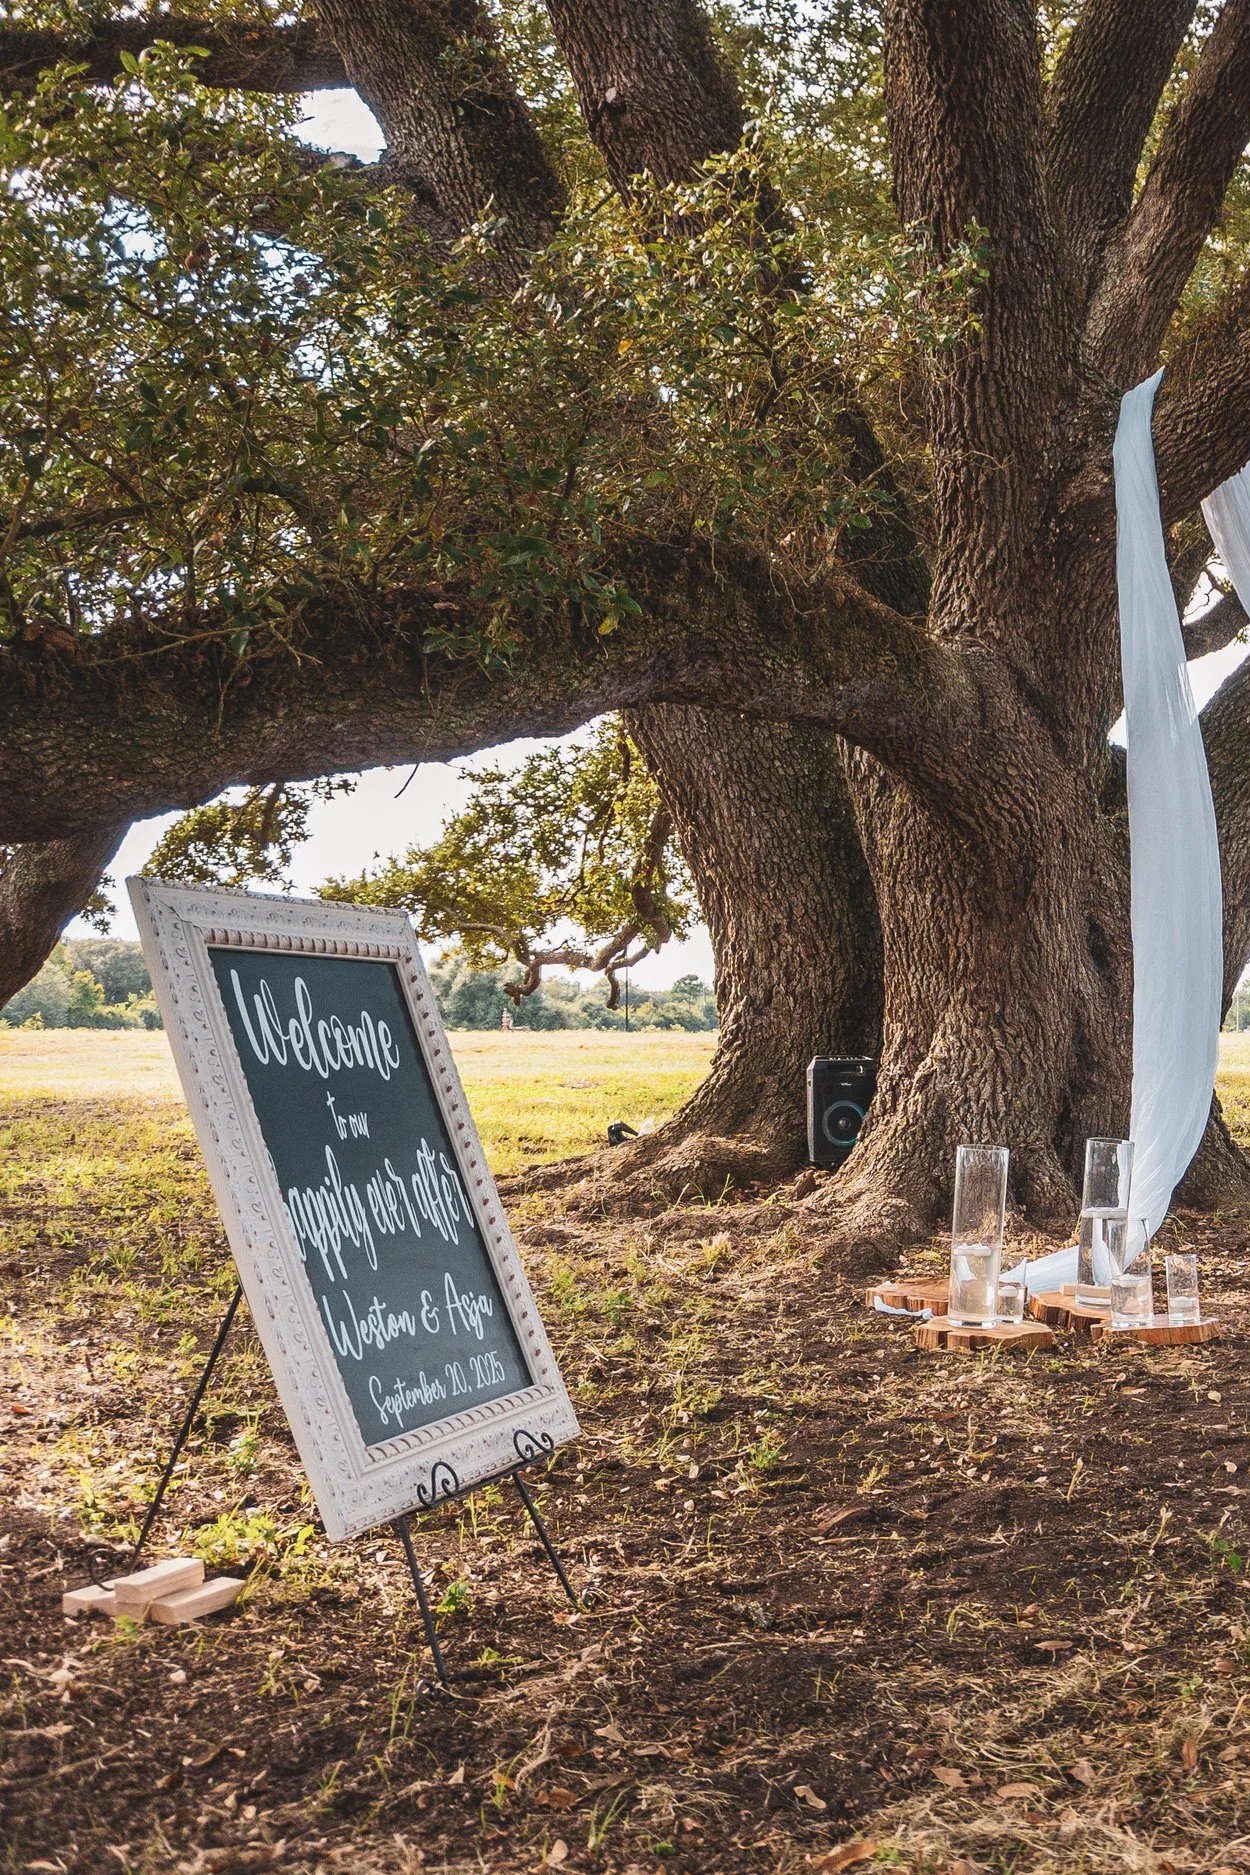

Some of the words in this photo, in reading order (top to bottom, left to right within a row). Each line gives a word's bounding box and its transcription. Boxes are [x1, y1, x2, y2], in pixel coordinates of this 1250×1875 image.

[230, 968, 400, 1081] Welcome
[326, 1090, 348, 1141] to
[348, 1111, 371, 1140] our
[366, 1157, 422, 1239] ever
[411, 1137, 475, 1246] after
[321, 1289, 416, 1361] Weston
[420, 1289, 440, 1334] &
[444, 1272, 494, 1341] Asja
[368, 1371, 447, 1429] September
[445, 1361, 473, 1397] 20,
[469, 1350, 506, 1389] 2025
